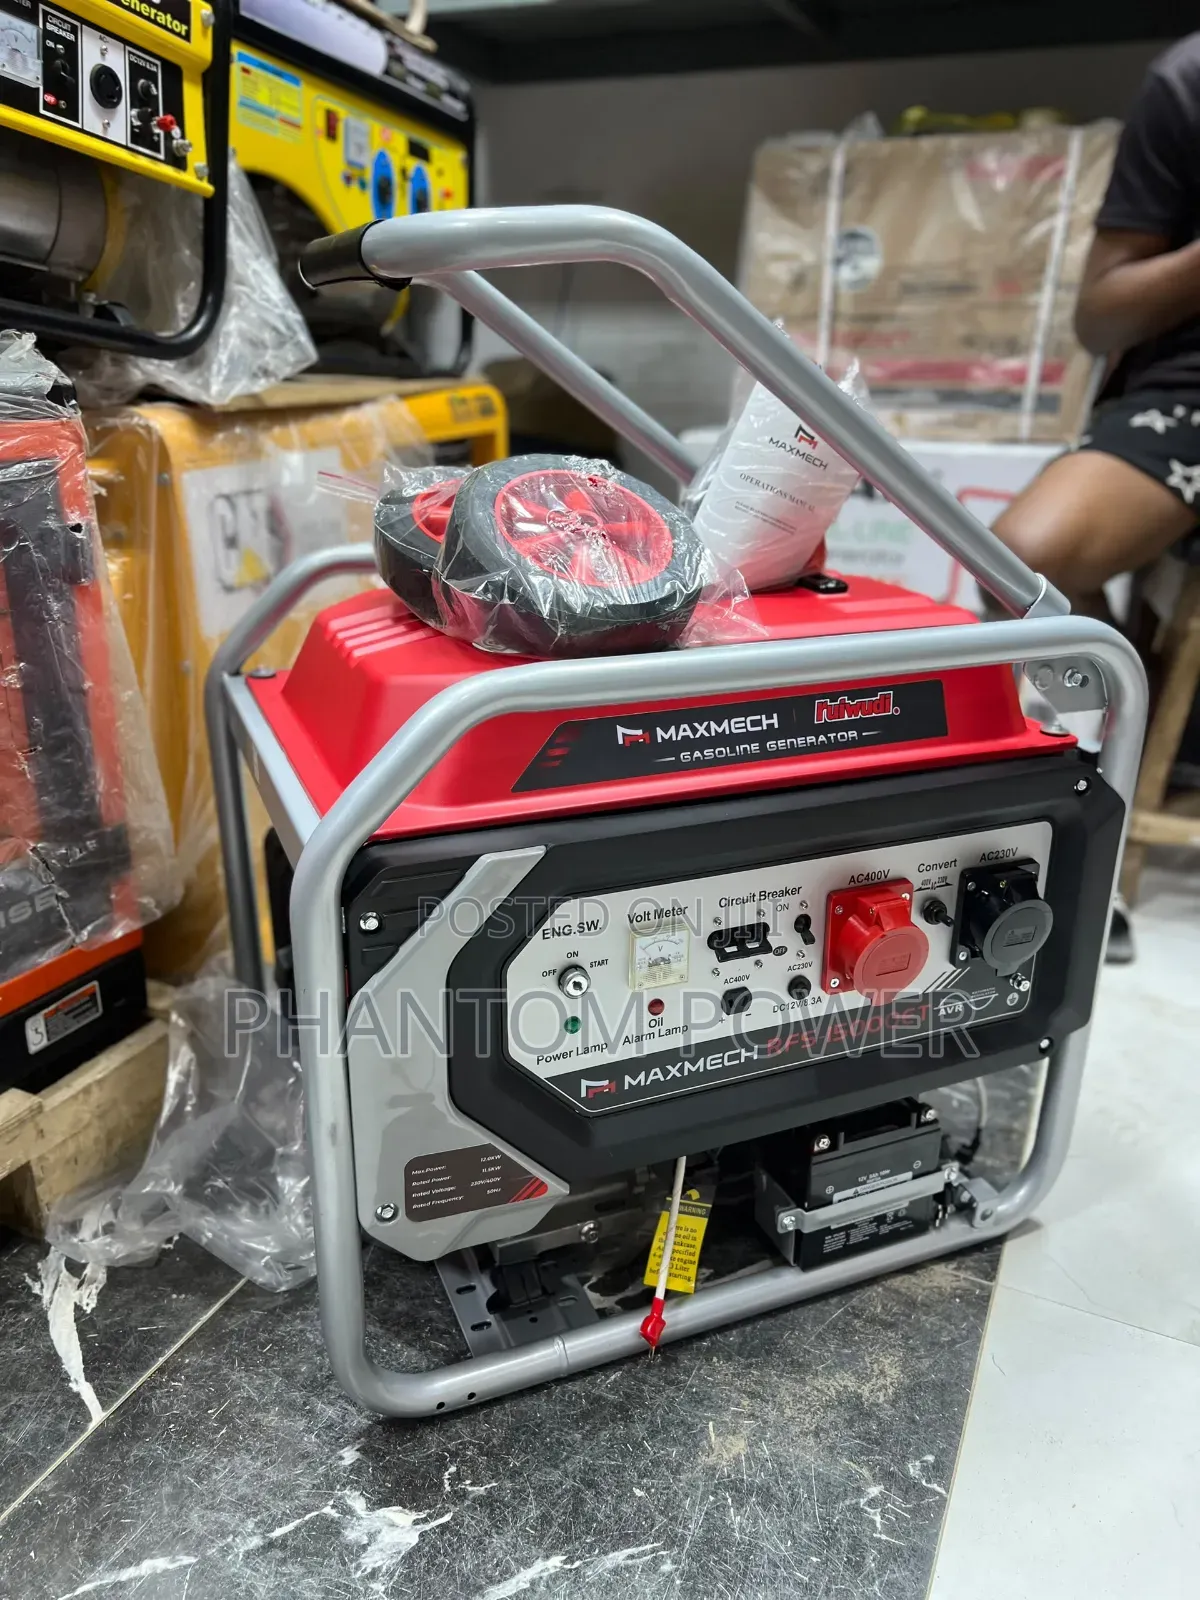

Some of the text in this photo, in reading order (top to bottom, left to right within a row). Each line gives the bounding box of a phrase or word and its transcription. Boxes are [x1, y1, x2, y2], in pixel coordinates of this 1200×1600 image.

[48, 14, 71, 31] CIRCUIT
[121, 0, 189, 36] enerator
[46, 22, 76, 42] BREAKER
[768, 437, 829, 470] MAXMECH
[657, 714, 779, 743] MAXMECH
[679, 729, 859, 764] GASOLINE GENERATOR
[979, 847, 1019, 863] AC230V
[917, 858, 958, 873] Convert
[848, 869, 890, 886] AC400V
[718, 884, 802, 908] Circuit Breaker
[627, 905, 689, 925] Volt Meter
[776, 903, 789, 912] ON
[541, 919, 602, 941] ENG.SW.
[566, 950, 579, 959] ON
[774, 946, 787, 955] OFF
[589, 958, 609, 969] START
[787, 960, 813, 972] AC230V
[541, 968, 557, 978] OFF
[723, 974, 750, 985] AC400V
[772, 996, 823, 1014] DC12V/8.3A
[938, 1003, 963, 1017] AVR
[648, 1017, 664, 1029] Oil
[622, 1023, 689, 1046] Alarm Lamp
[536, 1041, 609, 1065] Power Lamp
[623, 1045, 759, 1091] MAXMECH
[671, 1248, 696, 1257] pecified
